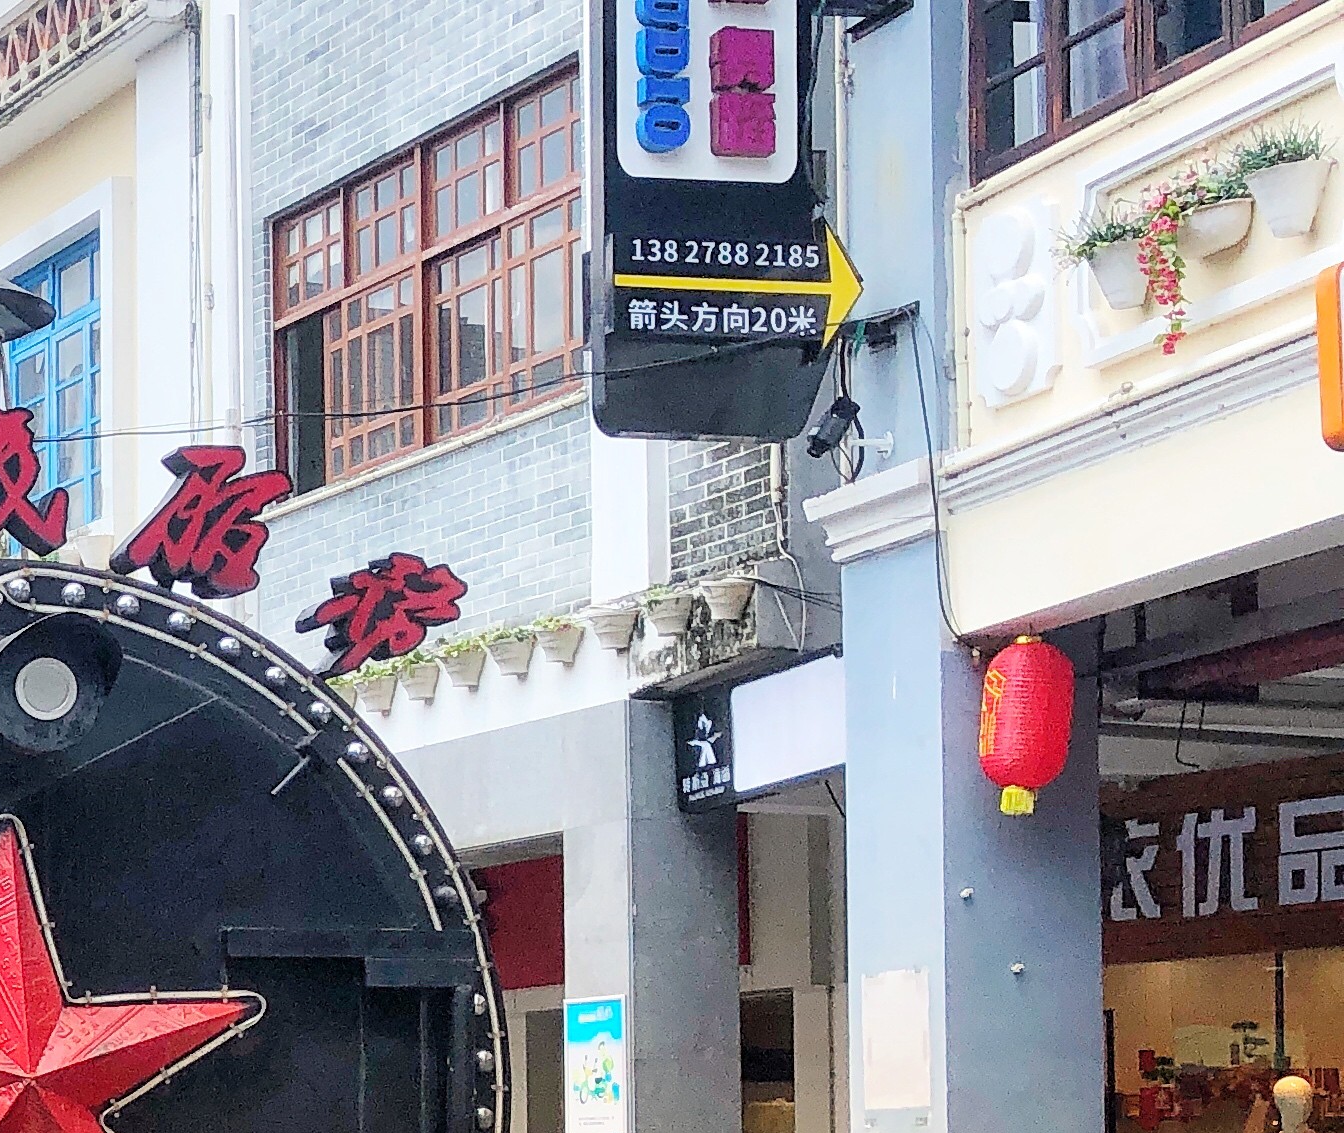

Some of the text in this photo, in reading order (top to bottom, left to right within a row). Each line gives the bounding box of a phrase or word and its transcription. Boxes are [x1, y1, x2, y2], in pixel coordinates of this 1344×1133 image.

[631, 238, 820, 268] 138 2788 2185
[628, 298, 817, 336] 箭头方向20米
